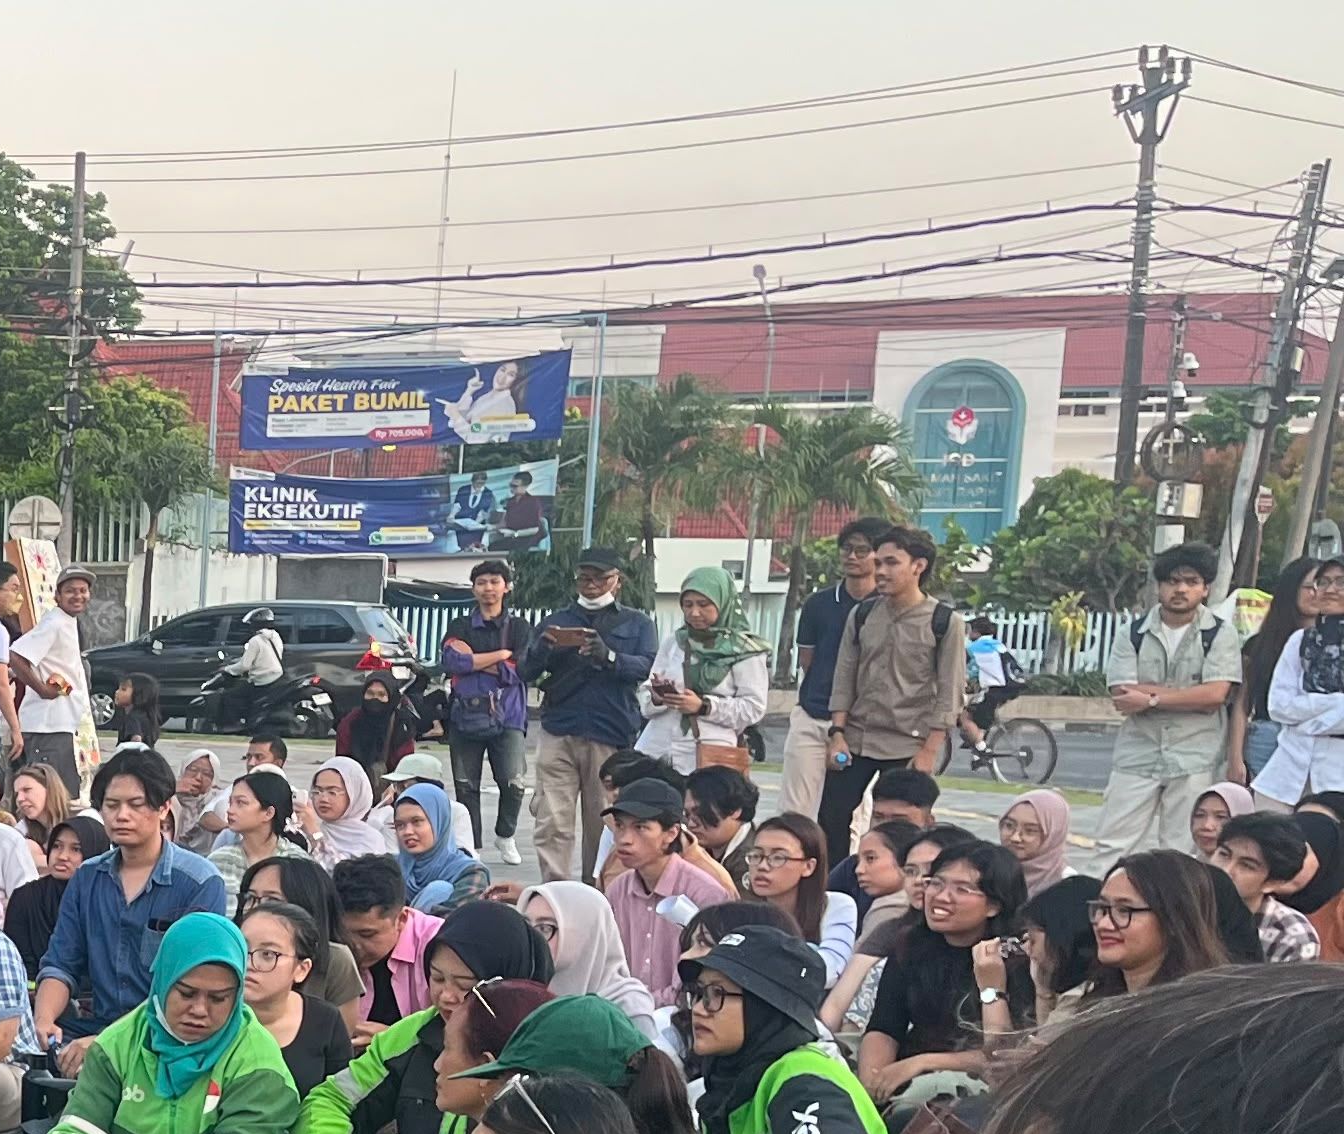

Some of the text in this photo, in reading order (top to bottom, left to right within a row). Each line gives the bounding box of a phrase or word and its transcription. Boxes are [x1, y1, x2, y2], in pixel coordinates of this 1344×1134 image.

[322, 378, 367, 391] Health
[371, 377, 400, 390] Fair
[268, 391, 430, 413] PAKET BUMIL
[244, 486, 318, 503] KLINIK
[243, 502, 364, 520] EKSEKUTIF
